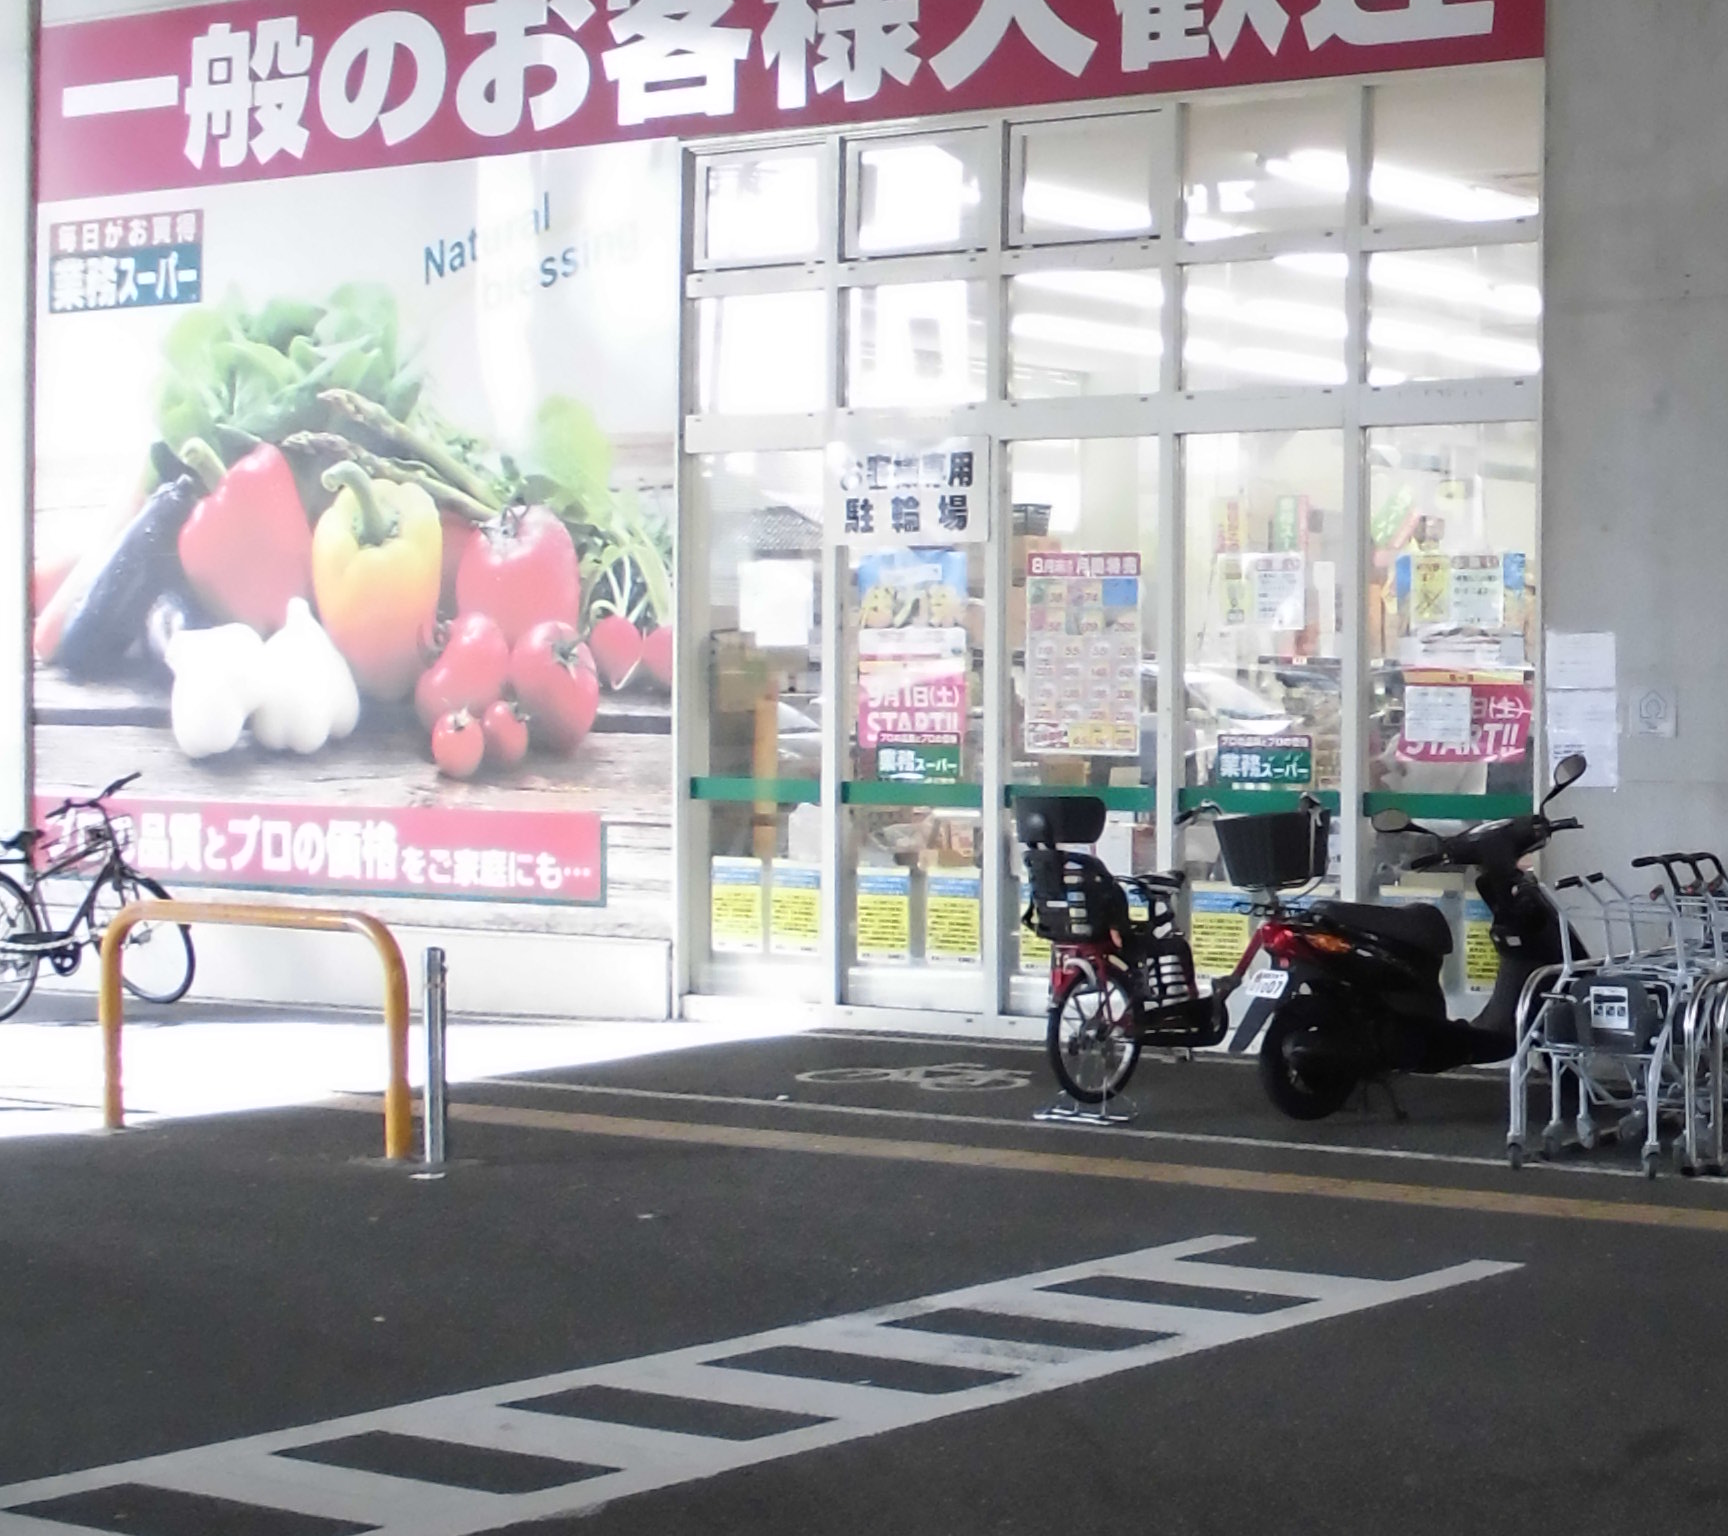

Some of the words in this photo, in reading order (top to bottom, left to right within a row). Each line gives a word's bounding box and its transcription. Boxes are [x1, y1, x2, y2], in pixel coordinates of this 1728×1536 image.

[58, 215, 196, 252] 毎日がお買得
[53, 252, 197, 310] 業務スーパー
[844, 495, 970, 533] 駐輪場
[879, 748, 958, 773] 業務スーパー
[1220, 753, 1309, 778] 業務スーパー
